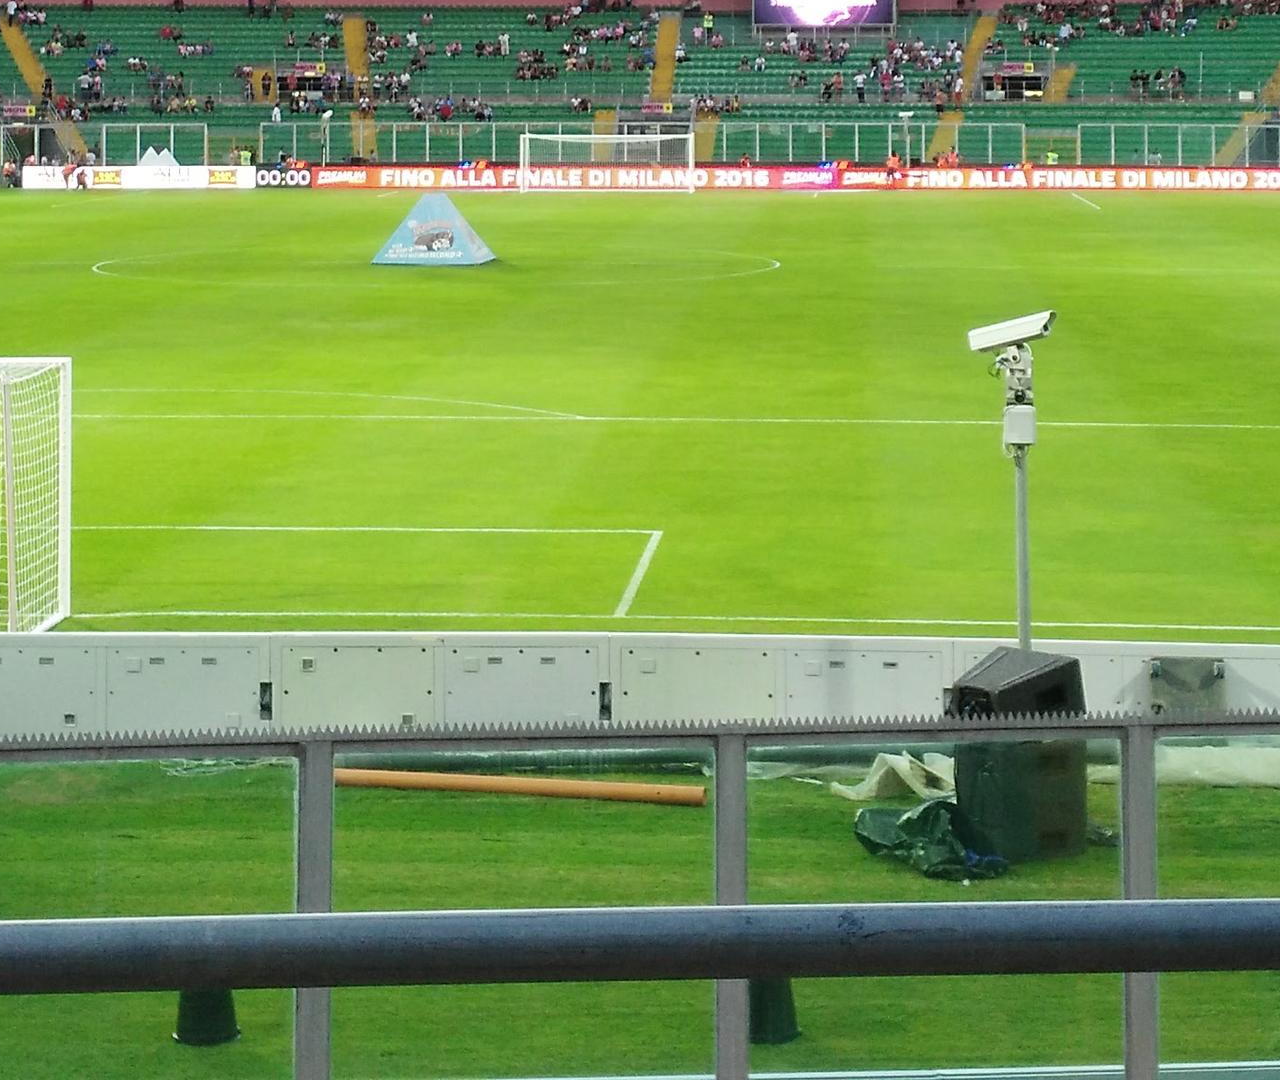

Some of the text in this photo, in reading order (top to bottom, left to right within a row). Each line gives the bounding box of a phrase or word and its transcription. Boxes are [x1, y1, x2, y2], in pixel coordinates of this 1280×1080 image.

[256, 169, 311, 186] 00:00
[380, 169, 770, 188] FINO ALLA FINALE DI MILANO 2016
[907, 168, 963, 188] FINO
[969, 168, 1029, 188] ALLA
[1032, 169, 1117, 189] FINALE
[1122, 169, 1145, 189] DI
[1152, 170, 1248, 189] MILANO
